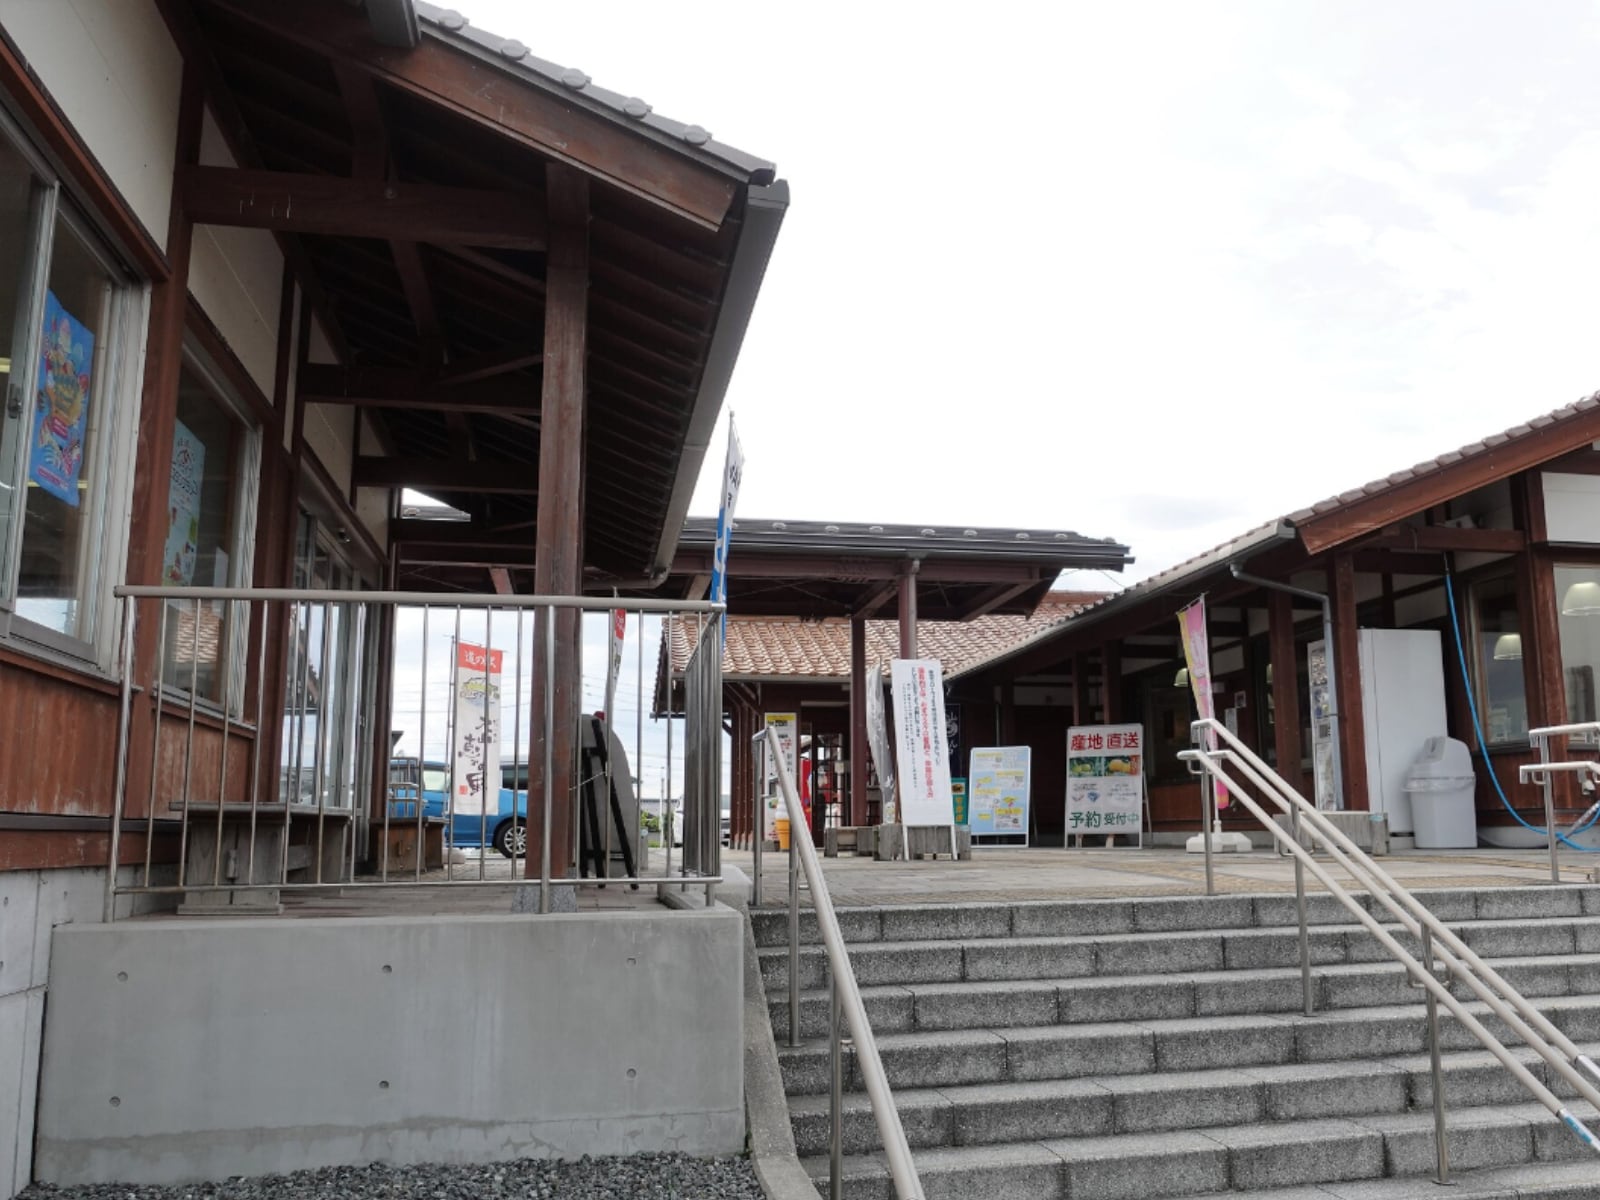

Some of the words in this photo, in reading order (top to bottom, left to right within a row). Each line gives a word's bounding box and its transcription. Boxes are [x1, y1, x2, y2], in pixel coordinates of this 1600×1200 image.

[1070, 732, 1139, 751] 産地直送
[1069, 811, 1139, 829] 予約受付中
